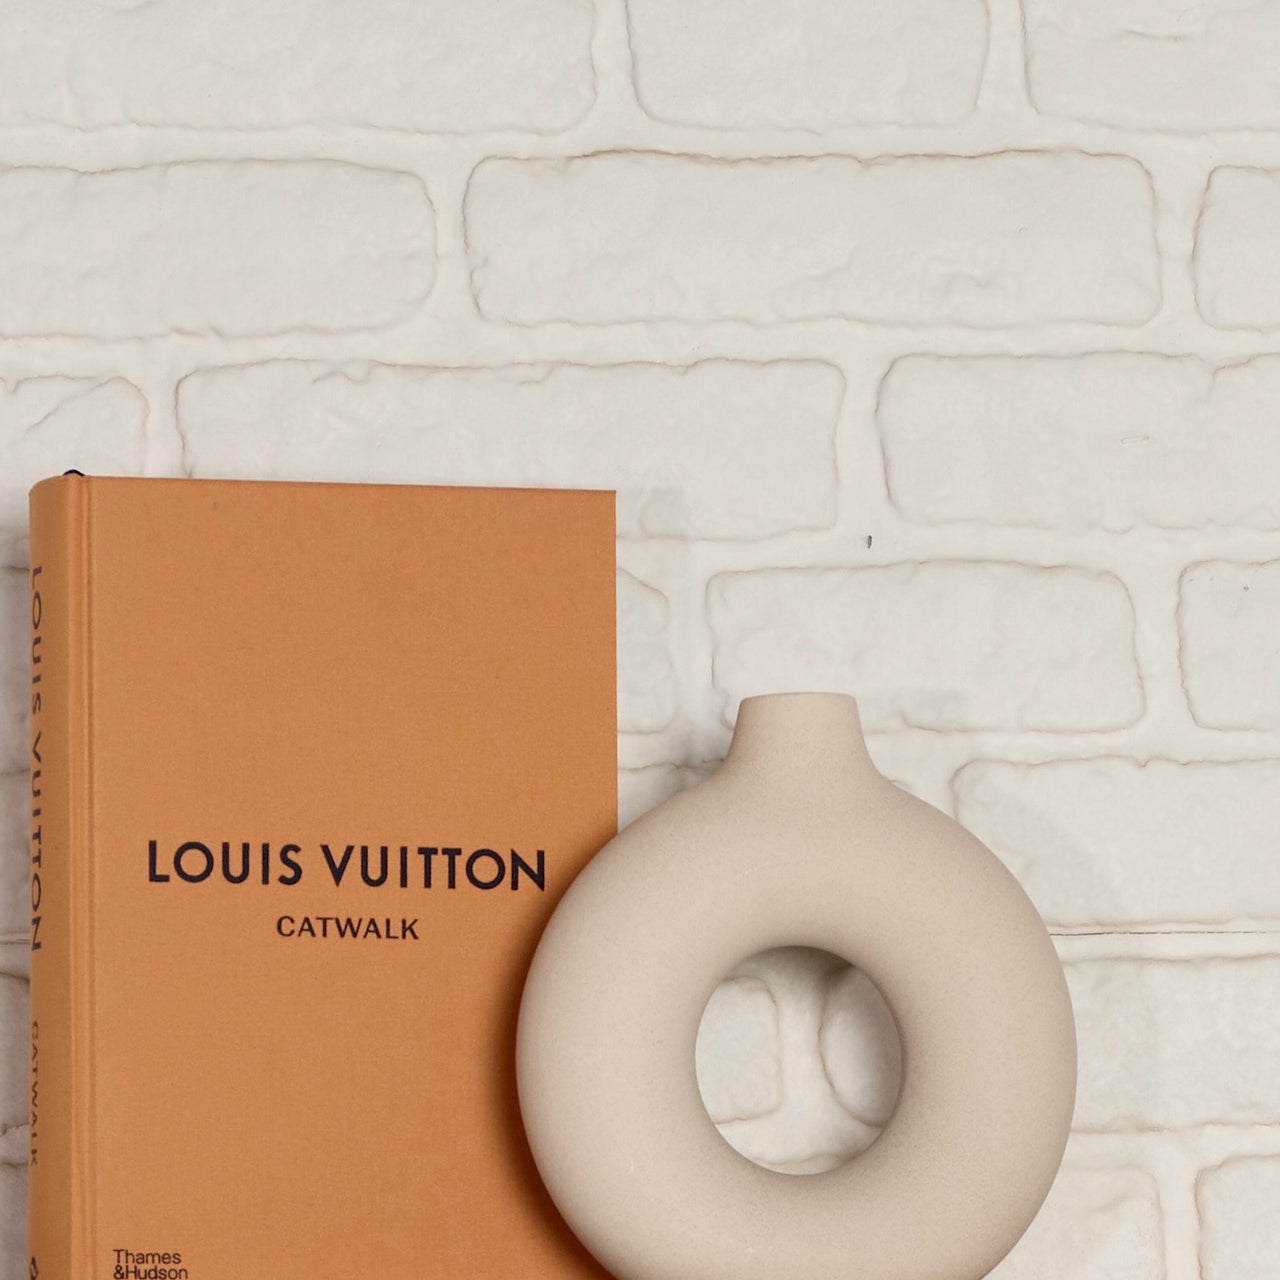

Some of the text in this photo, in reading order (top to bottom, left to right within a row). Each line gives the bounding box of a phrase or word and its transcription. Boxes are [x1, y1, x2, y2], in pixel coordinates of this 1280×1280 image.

[148, 840, 546, 892] LOUIS VUITTON
[276, 915, 420, 941] CATWALK
[113, 1248, 182, 1265] Thames
[113, 1265, 189, 1280] &Hudson
